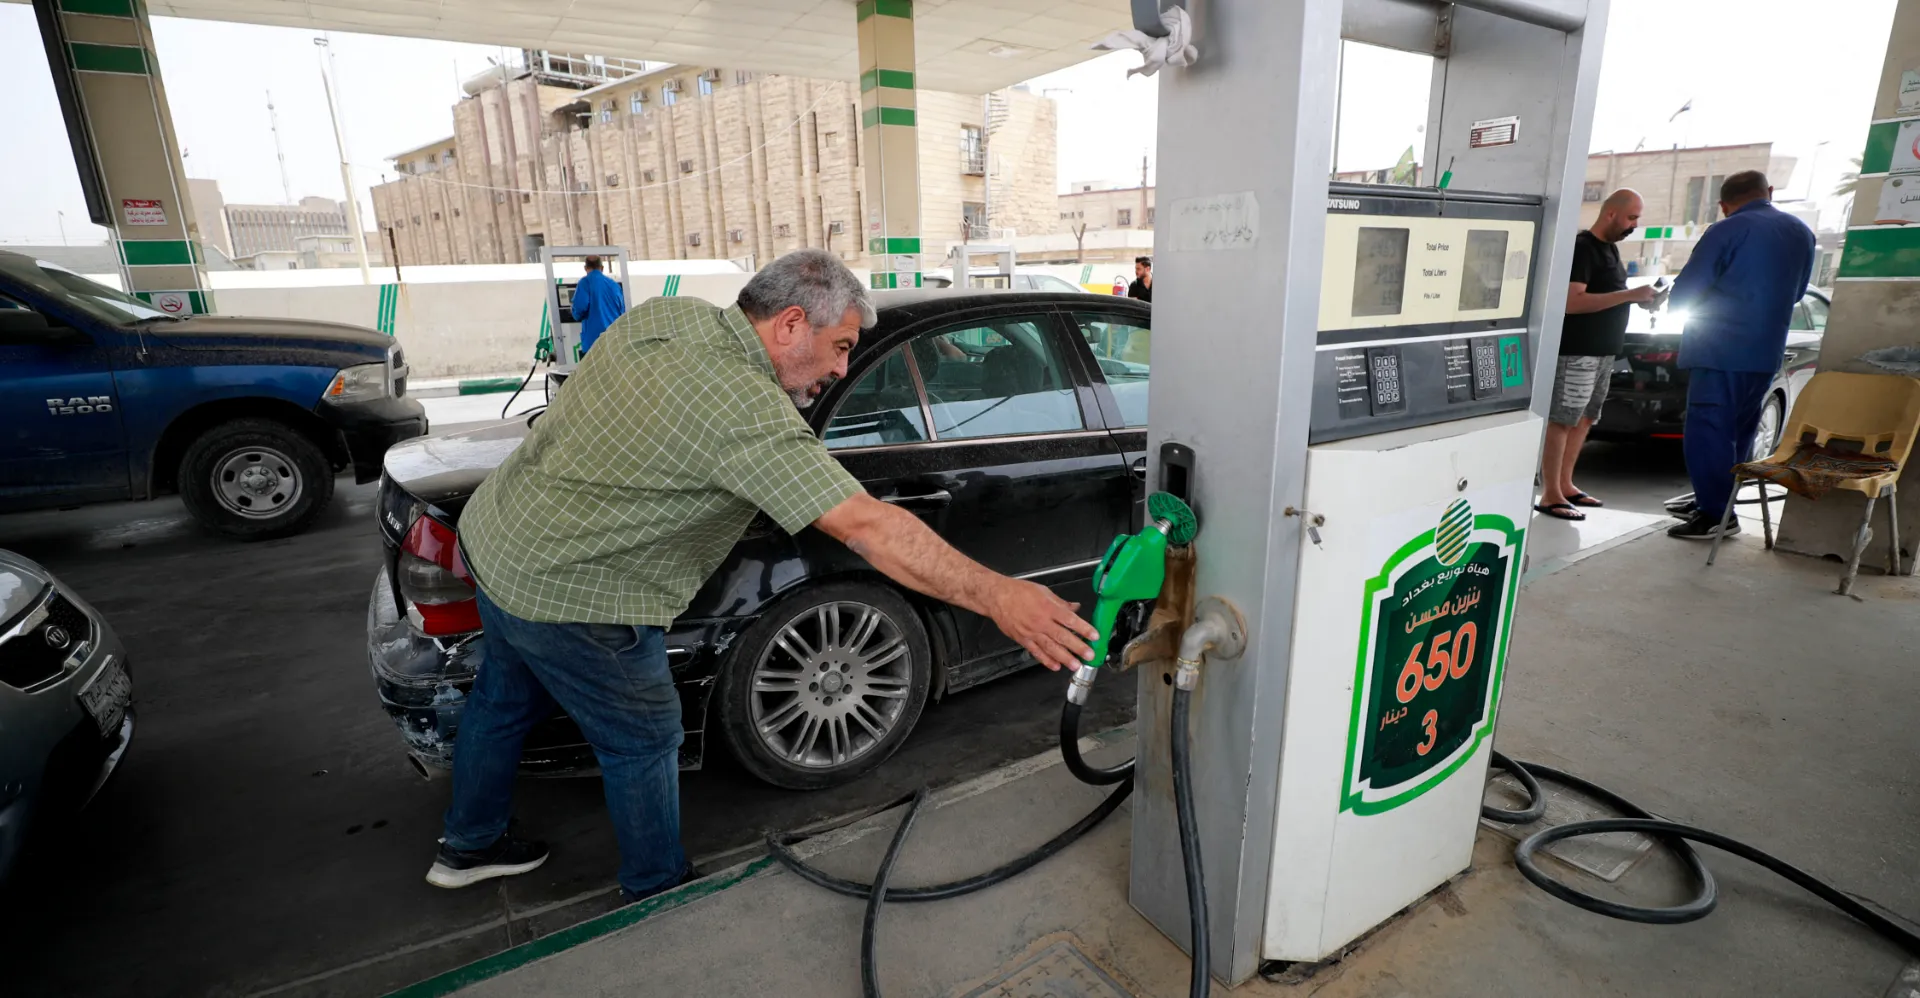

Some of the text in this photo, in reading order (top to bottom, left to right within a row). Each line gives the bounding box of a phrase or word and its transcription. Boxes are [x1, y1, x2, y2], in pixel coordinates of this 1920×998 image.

[1426, 243, 1449, 251] Total Price
[1423, 269, 1433, 277] Total
[46, 396, 112, 407] RAM
[48, 404, 113, 416] 1500
[1437, 564, 1467, 585] توزيع
[1402, 578, 1435, 607] بغداد
[1405, 585, 1481, 634] بنزين محسن
[1396, 621, 1477, 703] 650
[1379, 706, 1408, 732] دينار
[1416, 709, 1438, 756] 3
